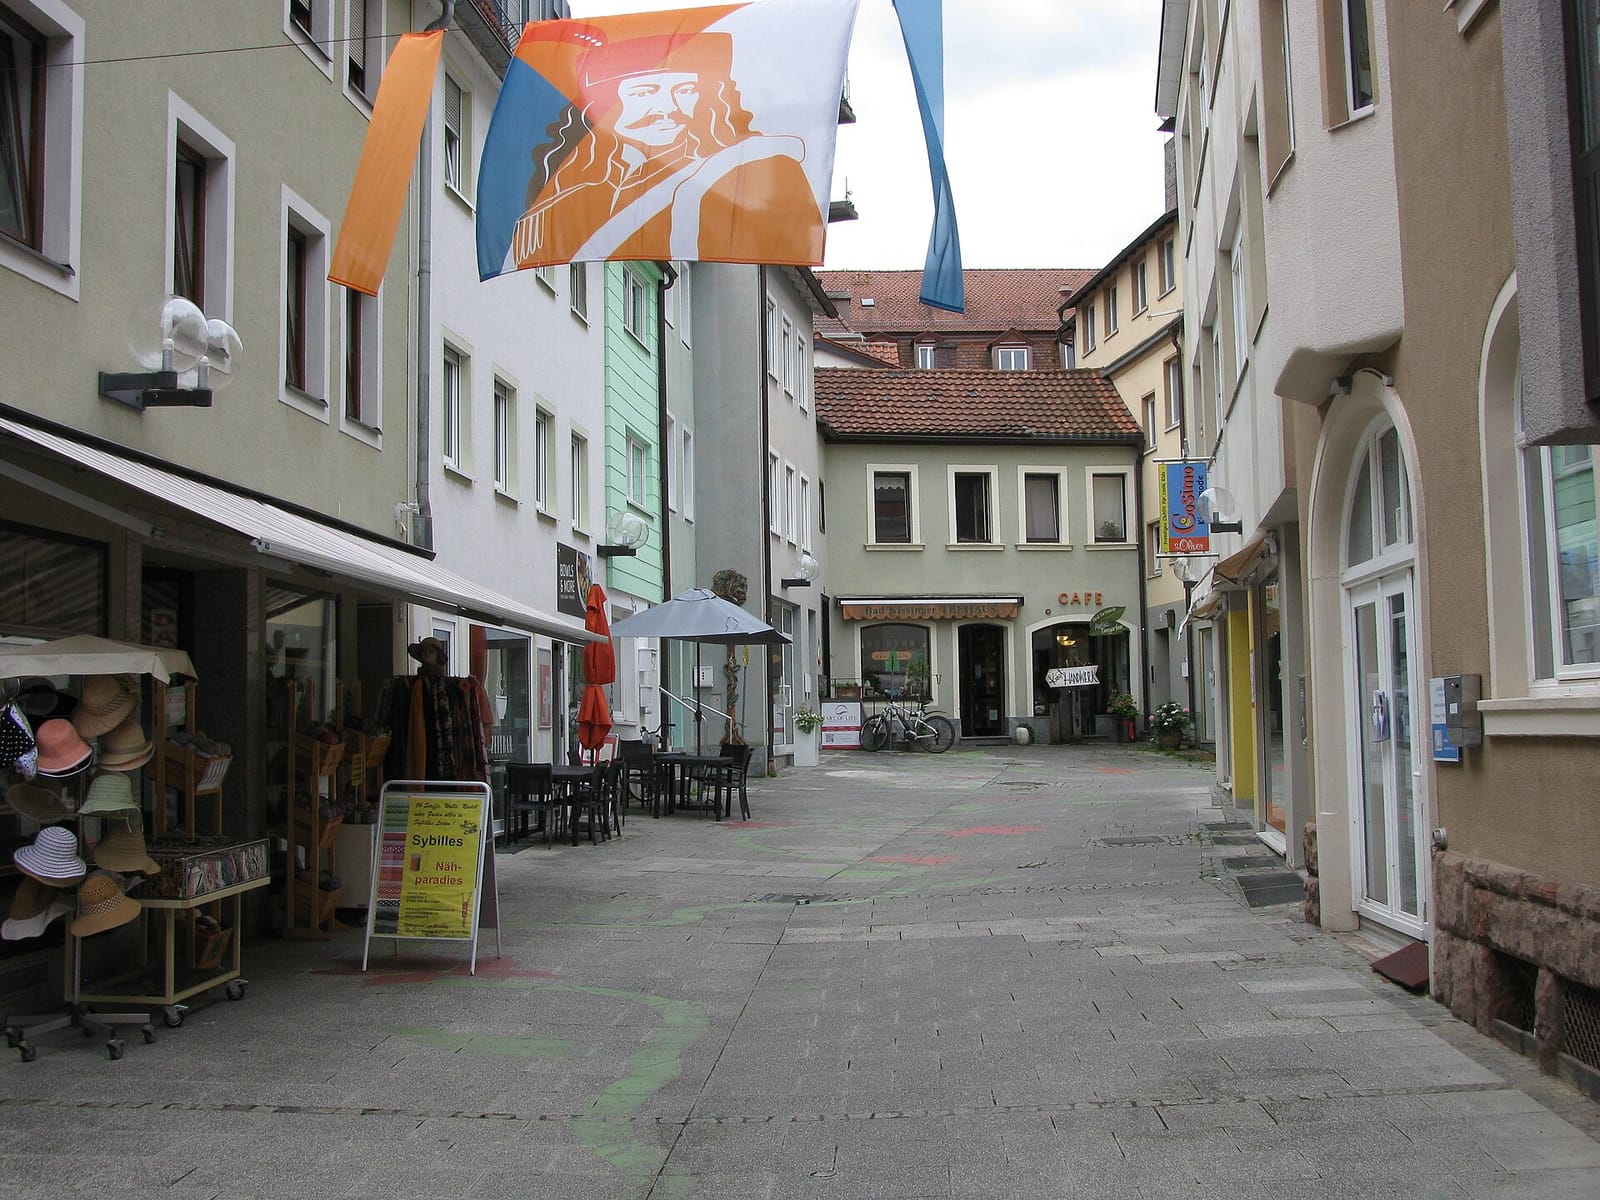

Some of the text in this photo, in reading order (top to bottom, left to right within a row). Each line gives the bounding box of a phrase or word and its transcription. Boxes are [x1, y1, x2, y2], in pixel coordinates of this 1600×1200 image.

[1172, 466, 1196, 534] Cosimo
[560, 563, 574, 577] BOWLS
[1058, 592, 1102, 605] CAFE
[412, 834, 464, 848] Sybilles
[436, 861, 463, 871] Näh-
[415, 875, 463, 886] paradies
